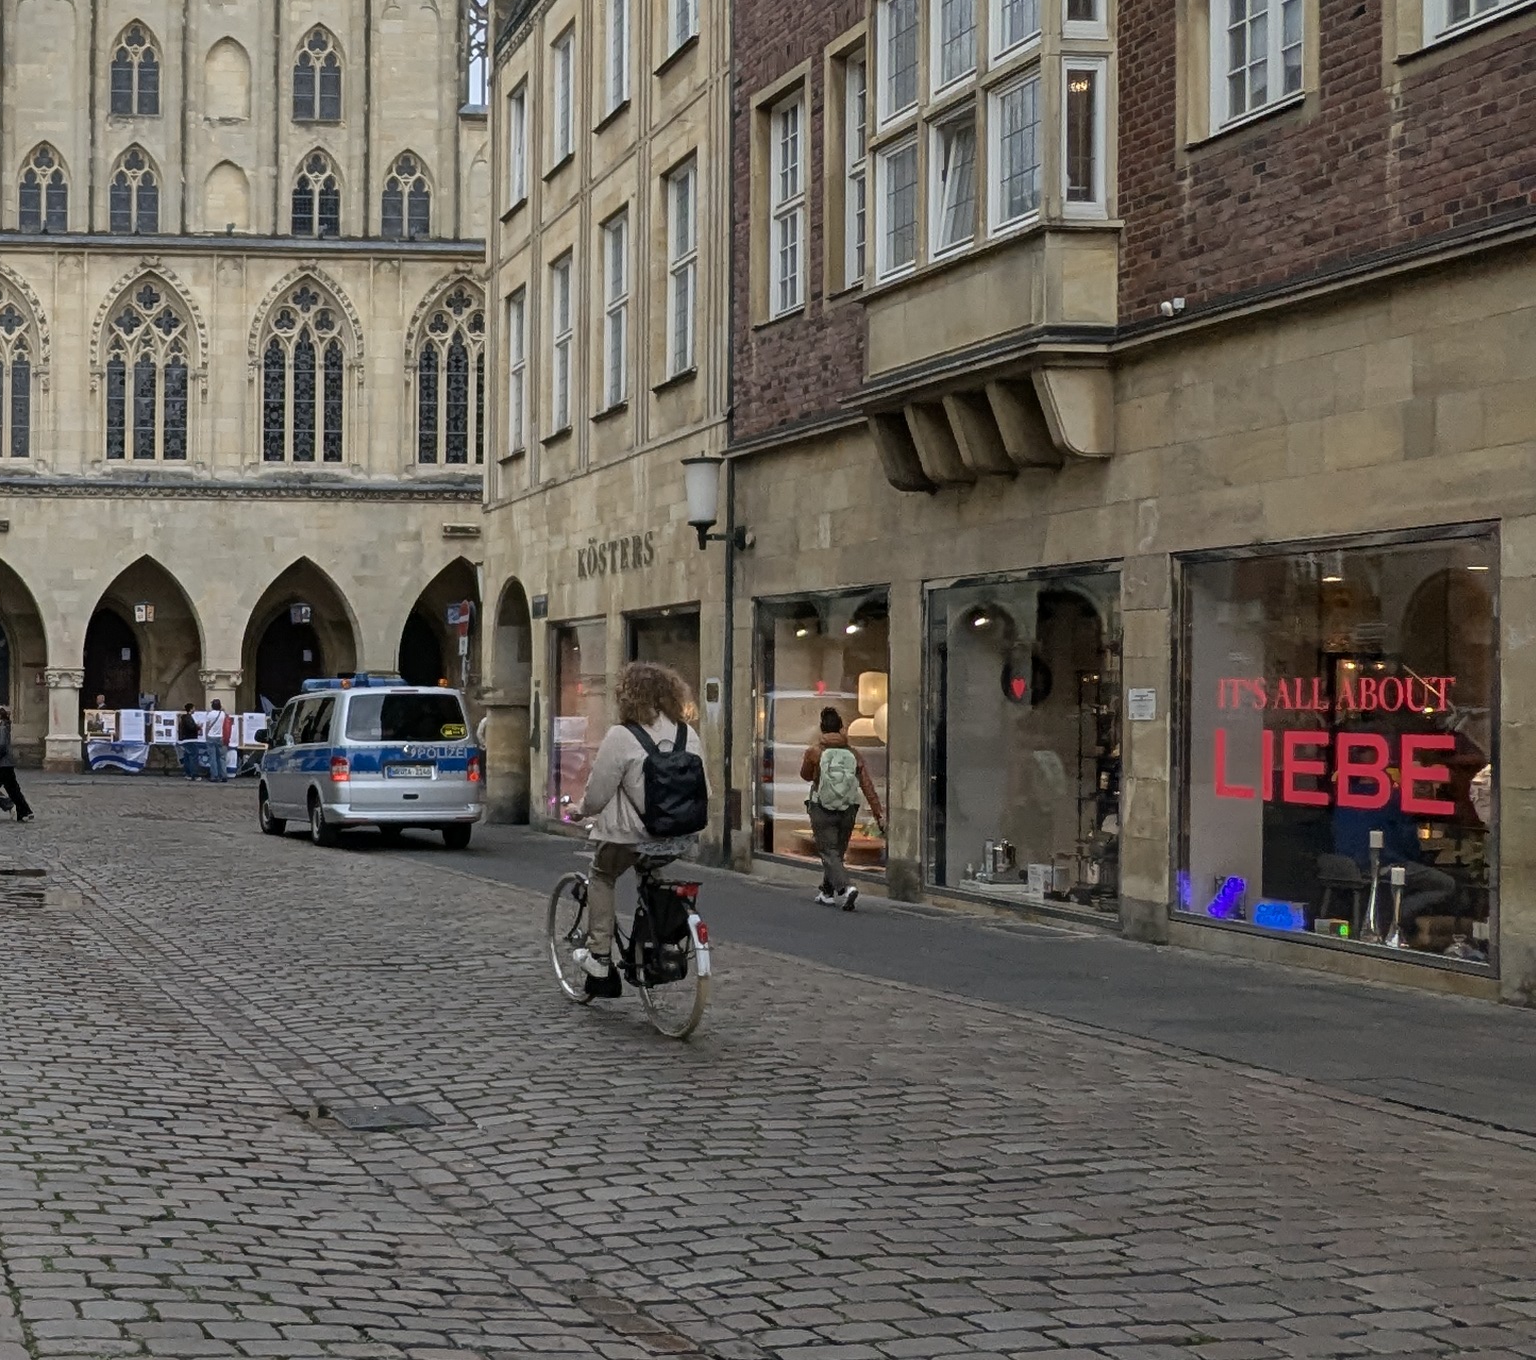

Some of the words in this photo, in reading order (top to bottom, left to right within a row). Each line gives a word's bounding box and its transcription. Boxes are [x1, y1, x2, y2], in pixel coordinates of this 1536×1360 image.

[577, 530, 654, 578] KÖSTERS
[1218, 676, 1267, 710] IT'S
[1273, 676, 1330, 711] ALL
[1335, 676, 1457, 713] ABOUT
[417, 746, 468, 759] POLIZEI
[1215, 728, 1455, 816] LIEBE
